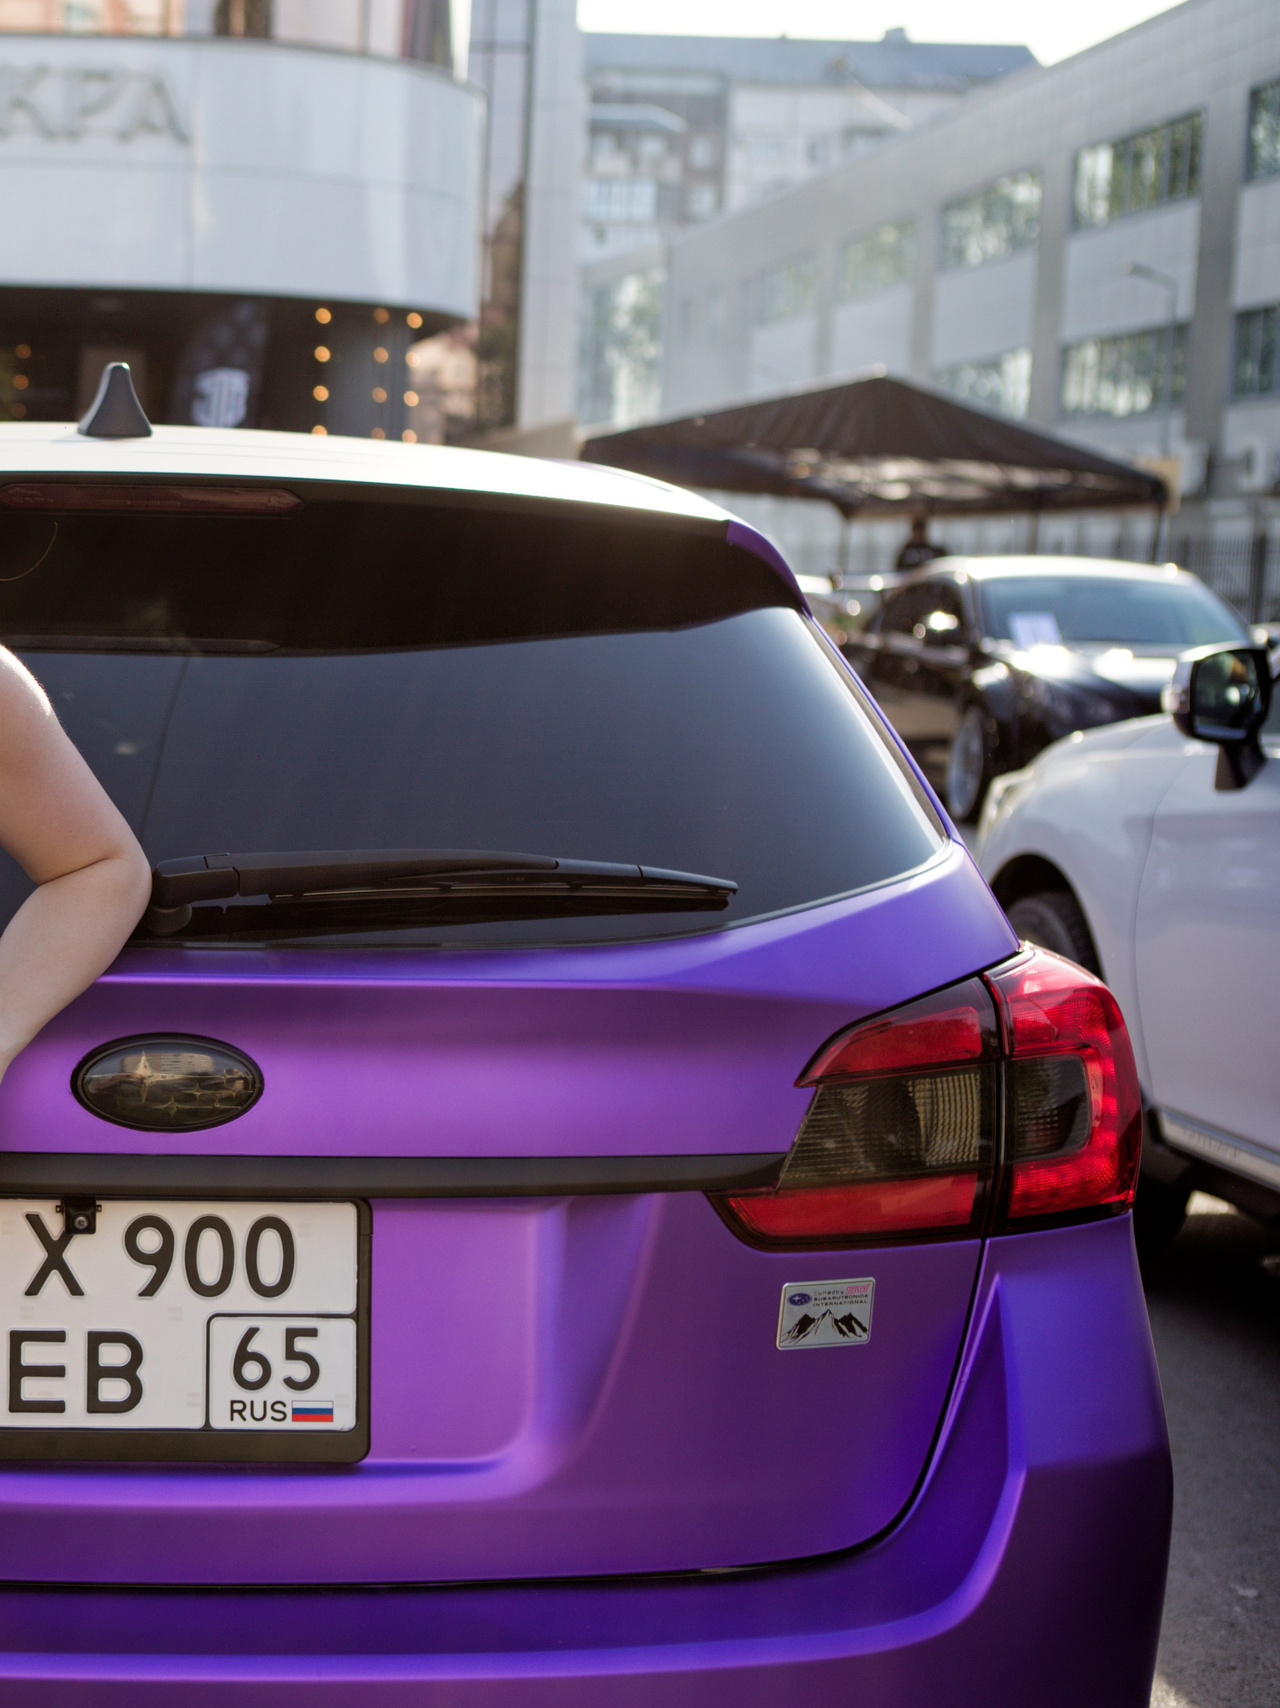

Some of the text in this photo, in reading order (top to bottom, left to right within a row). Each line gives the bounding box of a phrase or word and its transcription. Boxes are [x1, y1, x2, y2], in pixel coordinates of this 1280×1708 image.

[124, 1213, 296, 1299] 900
[233, 1327, 320, 1391] 65
[230, 1400, 287, 1422] RUS
